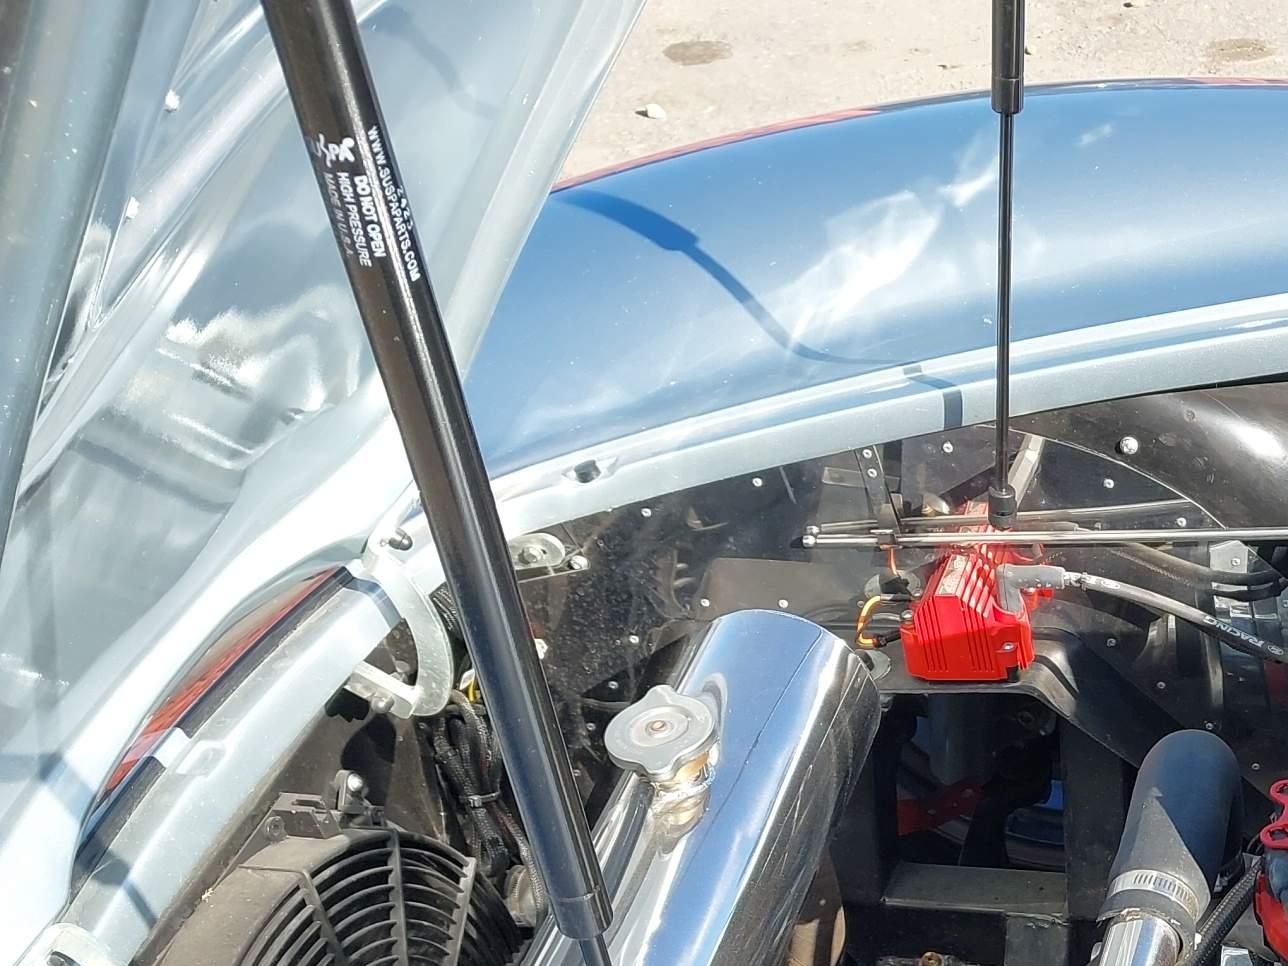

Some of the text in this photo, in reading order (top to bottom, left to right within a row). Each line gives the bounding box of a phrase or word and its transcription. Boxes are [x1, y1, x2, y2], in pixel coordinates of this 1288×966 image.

[336, 172, 372, 267] HIGH PRESSURE
[354, 175, 387, 257] DO NOT OPEN
[368, 126, 421, 282] WWW.SUSPAPARTS.COM
[1202, 615, 1265, 648] RACING
